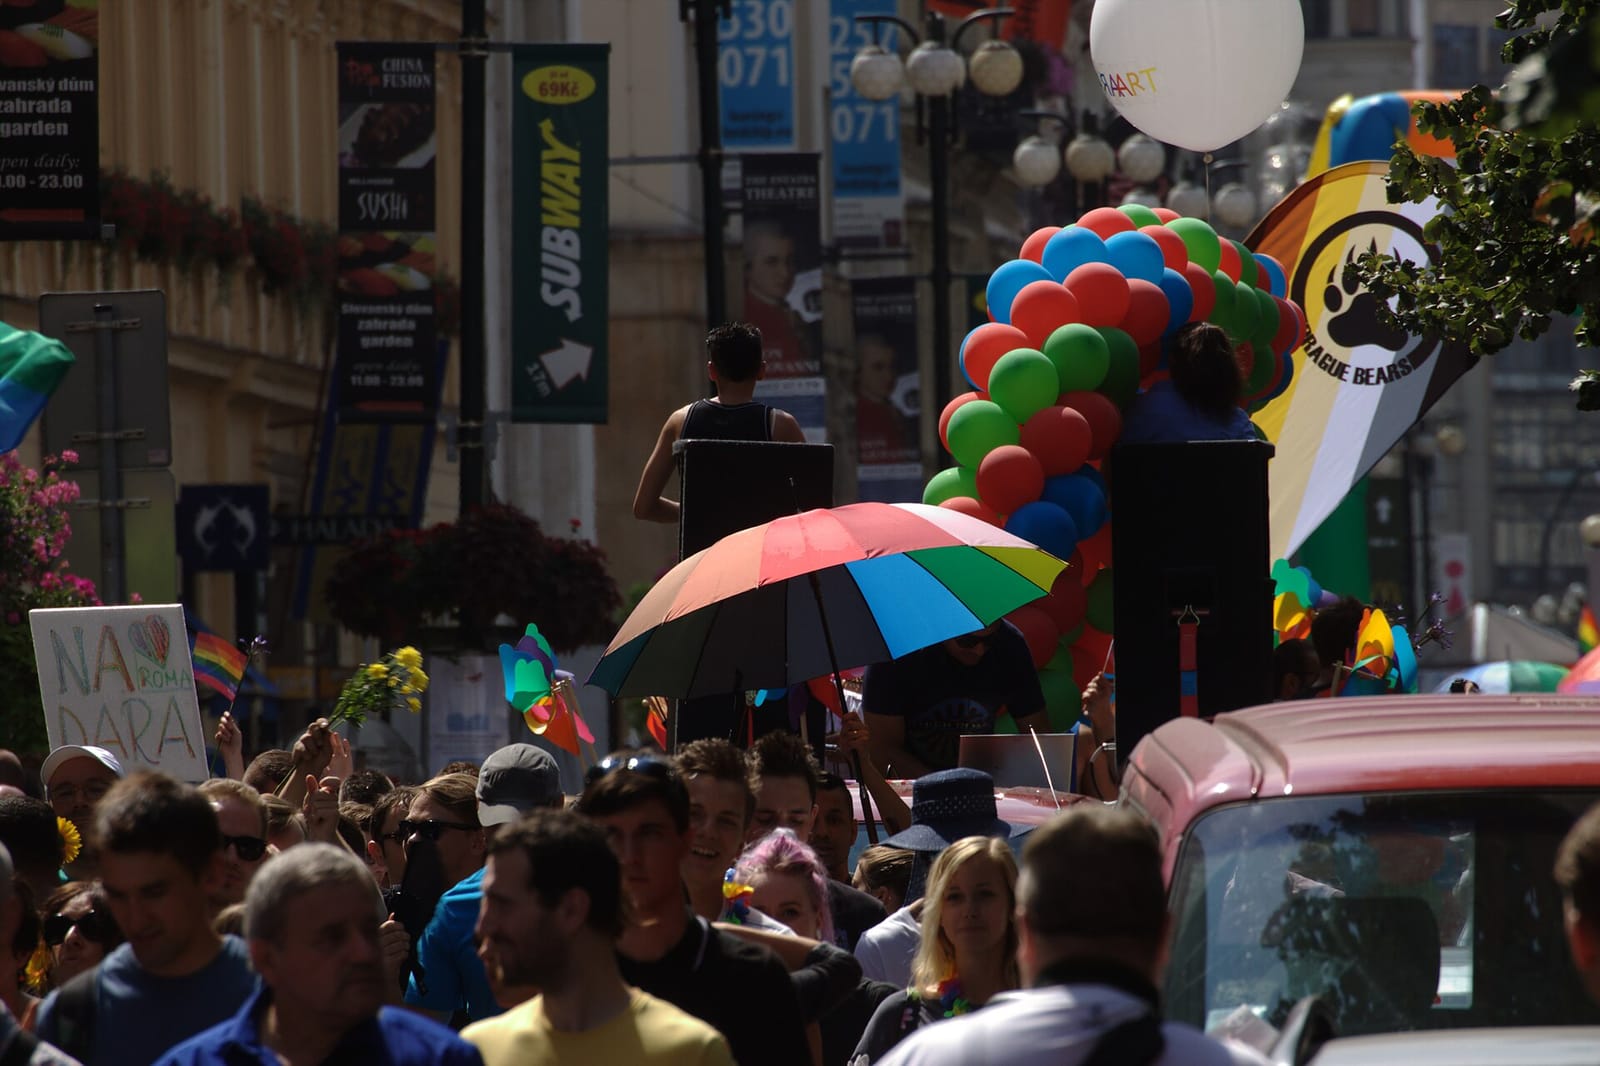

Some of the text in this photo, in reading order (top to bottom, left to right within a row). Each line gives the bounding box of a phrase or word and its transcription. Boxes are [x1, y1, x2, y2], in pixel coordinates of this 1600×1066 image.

[382, 57, 423, 73] CHINA
[718, 45, 789, 88] 071
[58, 77, 95, 92] dům
[382, 73, 432, 89] FUSION
[538, 81, 579, 97] 69Kč
[832, 104, 898, 143] 071
[34, 153, 81, 172] daily:
[38, 174, 84, 190] 23.00
[744, 186, 817, 200] THEATRE
[538, 116, 583, 322] SUBWAY
[1352, 355, 1412, 386] BEARS
[49, 624, 136, 696] NA
[58, 696, 197, 764] DARA
